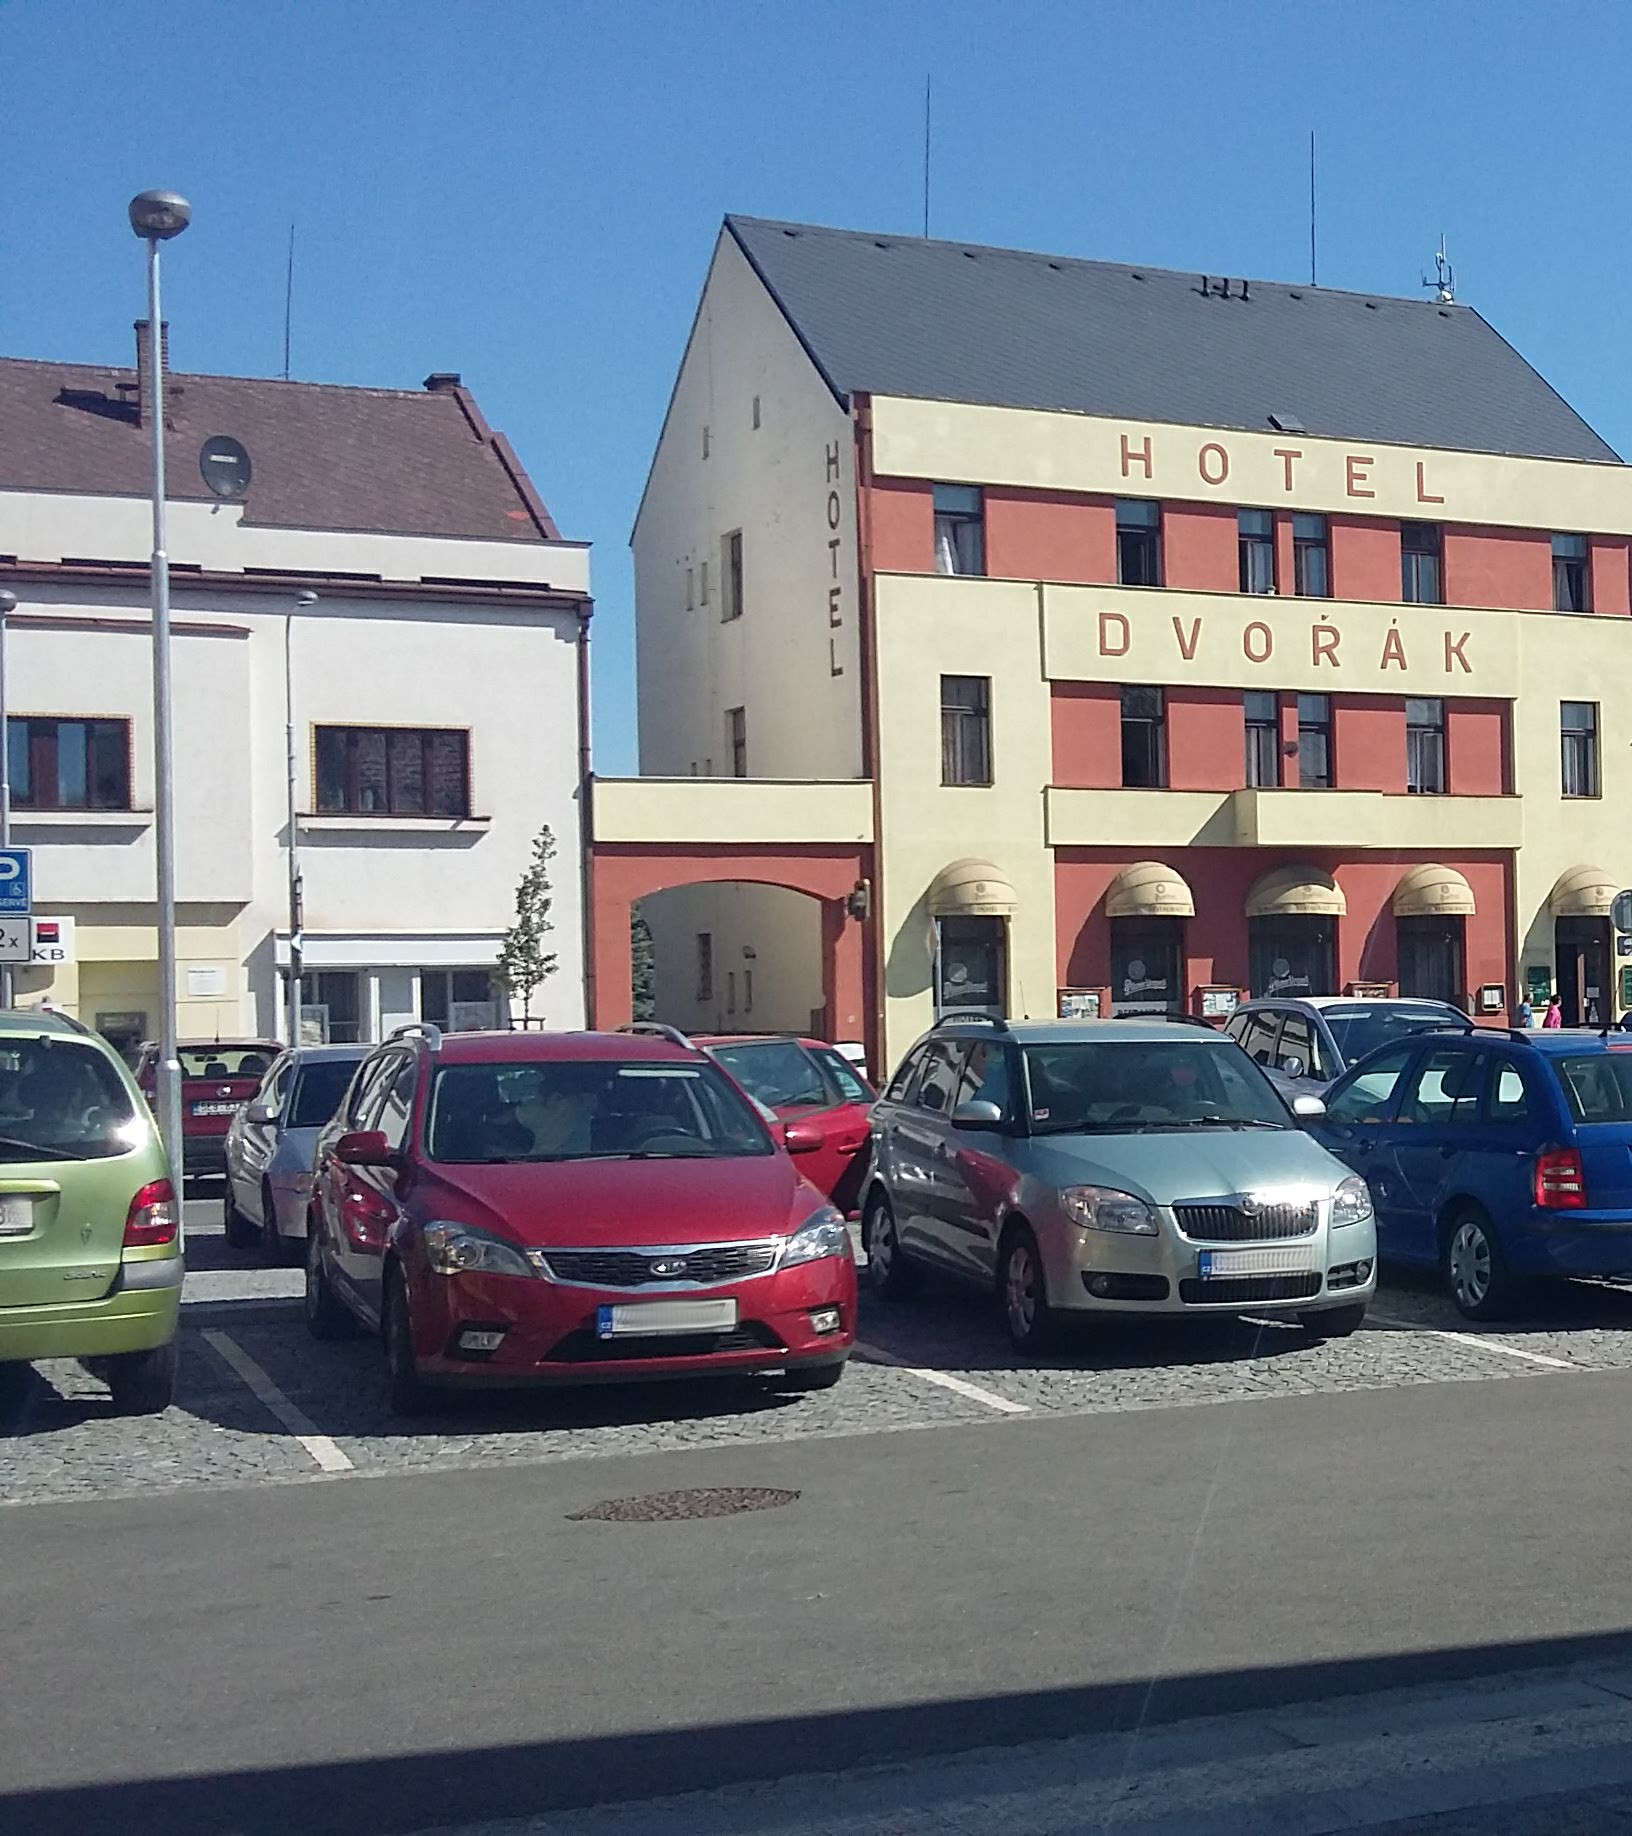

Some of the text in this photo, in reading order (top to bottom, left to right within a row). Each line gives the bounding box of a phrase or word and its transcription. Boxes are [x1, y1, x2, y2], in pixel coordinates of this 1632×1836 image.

[1120, 434, 1445, 504] HOTEL
[826, 440, 844, 677] HOTEL
[1099, 612, 1473, 673] DVOŘÁK
[32, 949, 65, 960] KB
